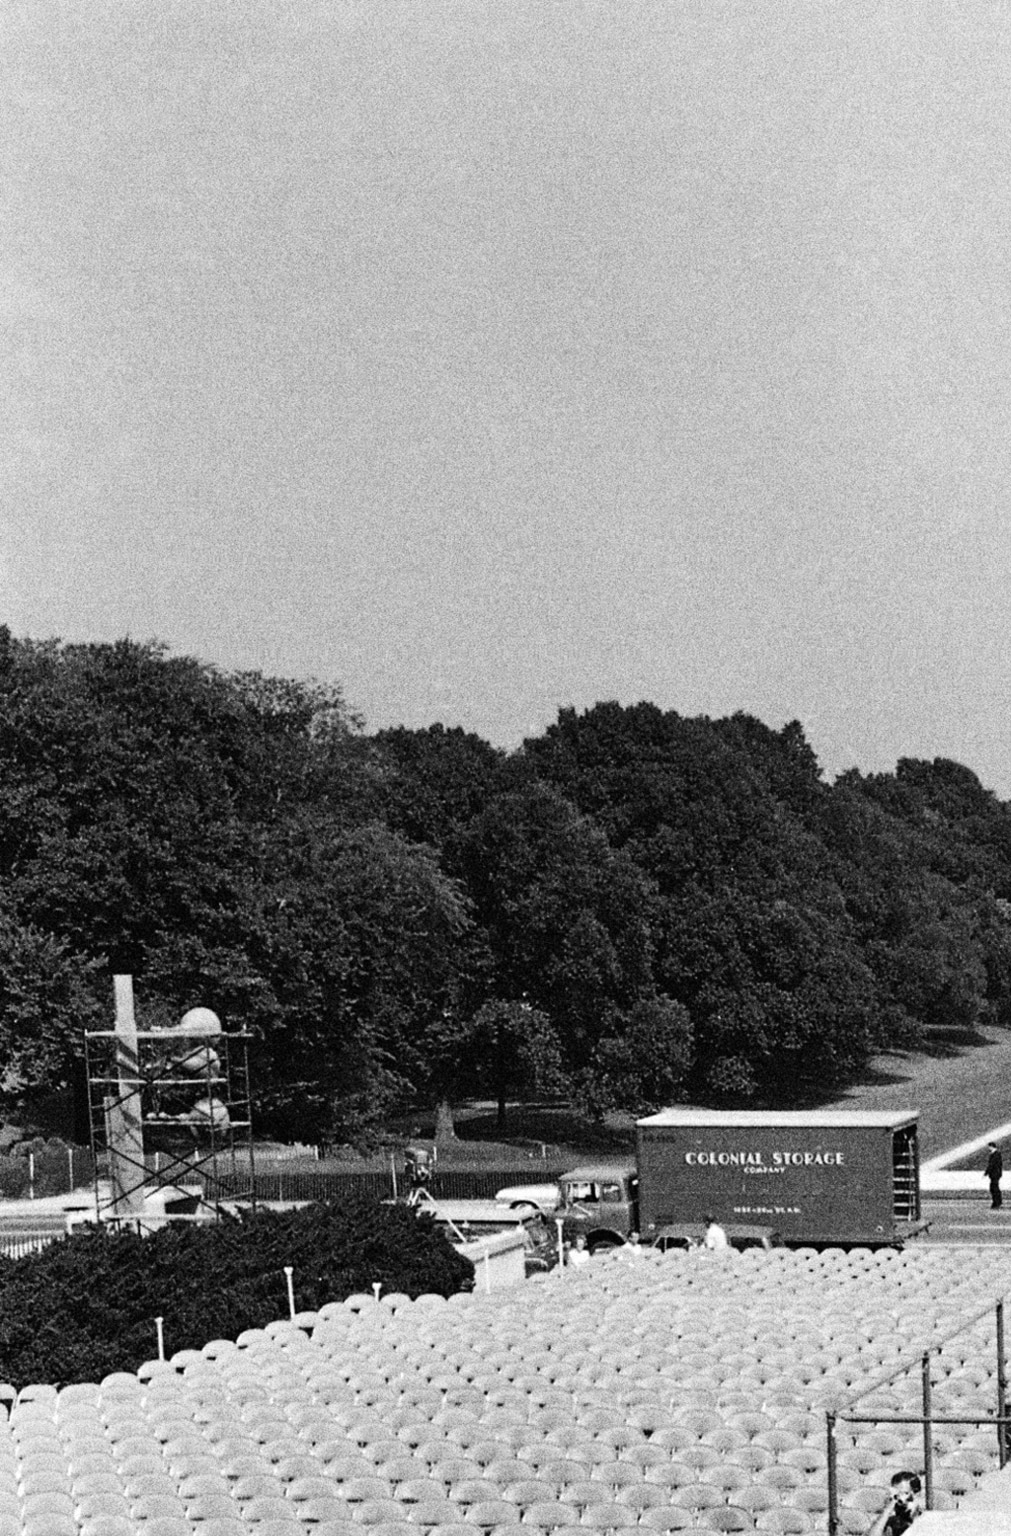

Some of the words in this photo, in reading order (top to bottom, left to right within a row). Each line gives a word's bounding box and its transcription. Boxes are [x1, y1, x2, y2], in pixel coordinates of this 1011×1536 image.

[685, 1152, 763, 1165] COLONIAL
[772, 1152, 844, 1165] STORAGE
[743, 1166, 785, 1174] COMPANY
